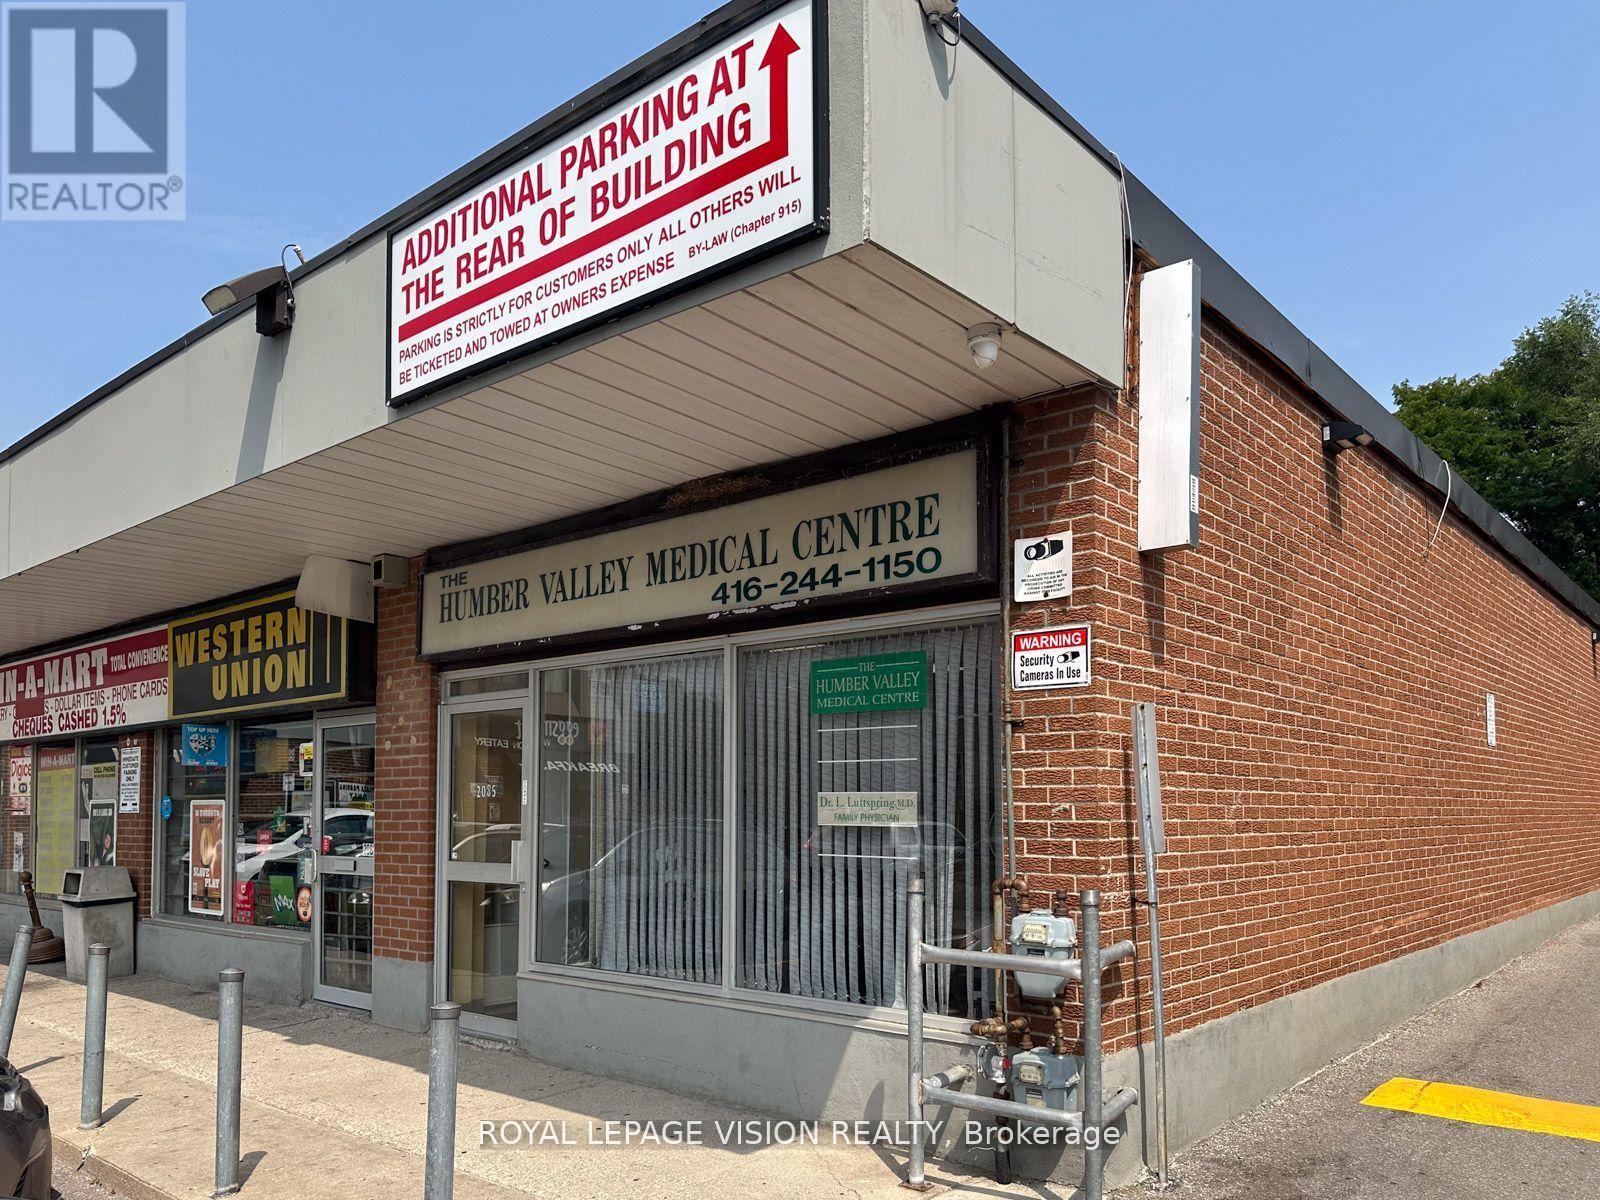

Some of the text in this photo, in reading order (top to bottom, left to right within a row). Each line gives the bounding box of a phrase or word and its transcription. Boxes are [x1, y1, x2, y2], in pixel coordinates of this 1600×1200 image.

[402, 39, 754, 275] ADDITIONAL PARKING AT
[402, 102, 751, 314] THE REAR OF BUILDING
[688, 198, 802, 260] BY-LAW (Chapter 915)
[399, 165, 801, 364] PARKING IS STRICTLY FOR CUSTOMERS ONLY ALL OTHERS WILL
[399, 252, 675, 386] BE TICKETED AND TOWED AT OWNERS EXPENSE
[438, 493, 941, 624] HUMBER VALLEY MEDICAL CENTRE
[439, 569, 468, 590] THE
[711, 546, 943, 605] 416-244-1150
[176, 606, 306, 668] WESTERN
[1020, 631, 1082, 650] WARNING
[110, 644, 168, 672] TOTAL CONVENIENCE
[858, 661, 876, 673] THE
[1020, 653, 1055, 668] Security
[212, 649, 306, 700] UNION
[816, 671, 920, 694] HUMBER VALLEY
[1020, 666, 1081, 682] Cameras In Use
[54, 695, 82, 713] DOLLAR
[83, 690, 105, 708] ITEMS
[112, 683, 138, 703] PHONE
[140, 679, 168, 700] CARDS
[817, 691, 920, 708] MEDICAL CENTRE
[12, 703, 126, 738] CHEQUES CASHED 1.5%
[820, 796, 834, 808] Dr.
[836, 796, 845, 808] L.
[834, 812, 900, 823] FAMILY PHYSICIAN
[193, 867, 210, 877] SLAVE
[204, 878, 220, 889] PLAY
